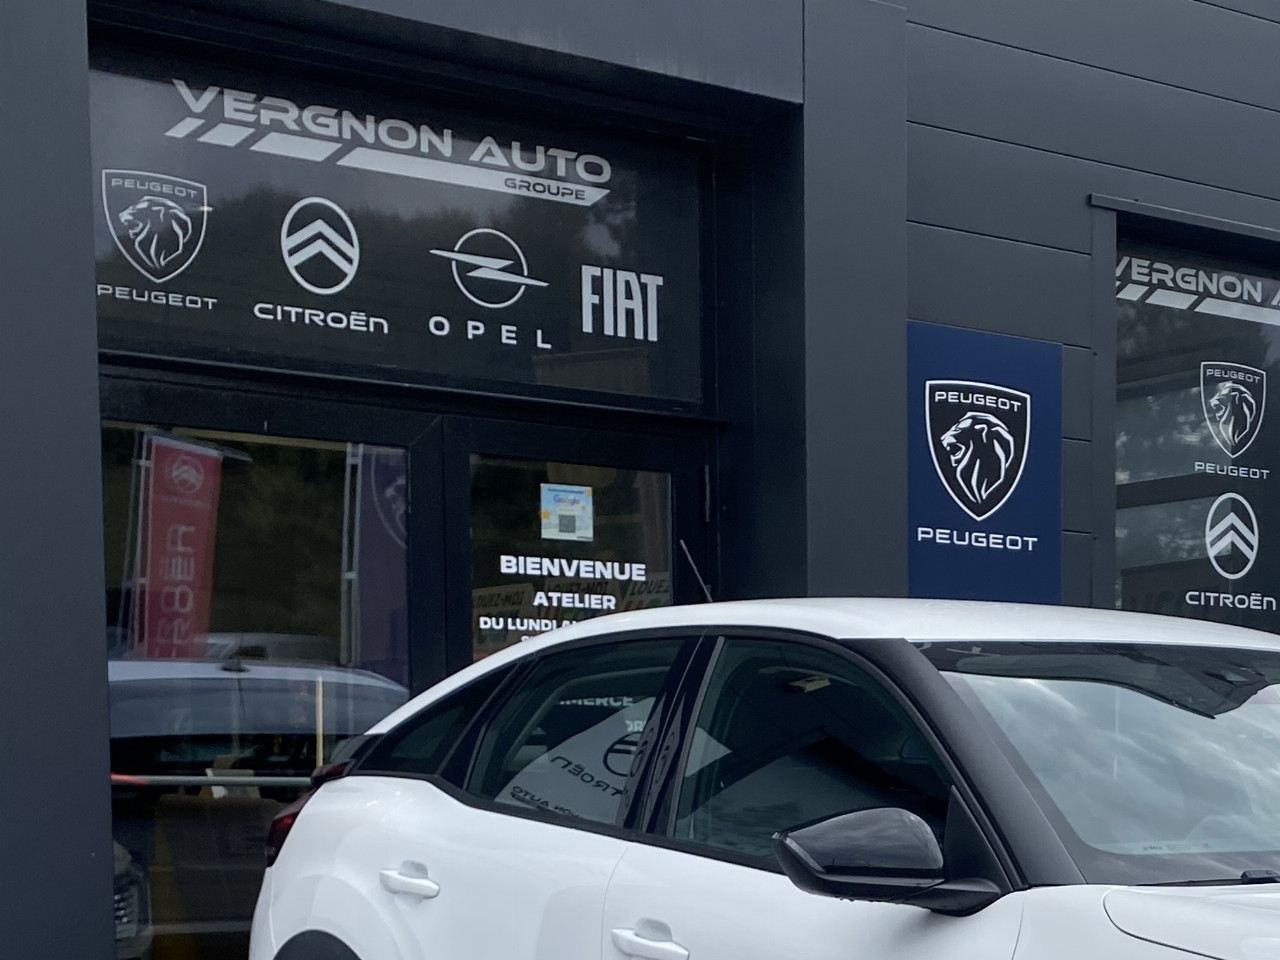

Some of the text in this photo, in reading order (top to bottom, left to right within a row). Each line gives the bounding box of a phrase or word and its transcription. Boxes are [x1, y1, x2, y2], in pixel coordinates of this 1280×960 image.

[172, 79, 612, 183] VERGNON AUTO
[110, 177, 198, 199] PEUGEOT
[503, 176, 586, 201] GROUPE
[96, 283, 218, 311] PEUGEOT
[580, 263, 663, 342] FIAT
[428, 314, 553, 350] OPEL
[1205, 368, 1260, 384] PEUGEOT
[934, 390, 1022, 413] PEUGEOT
[1194, 461, 1270, 480] PEUGEOT
[917, 526, 1038, 552] PEUGEOT
[500, 554, 646, 581] BIENVENUE
[533, 591, 617, 610] ATELIER
[479, 616, 504, 630] DU
[507, 617, 557, 631] LUNDI
